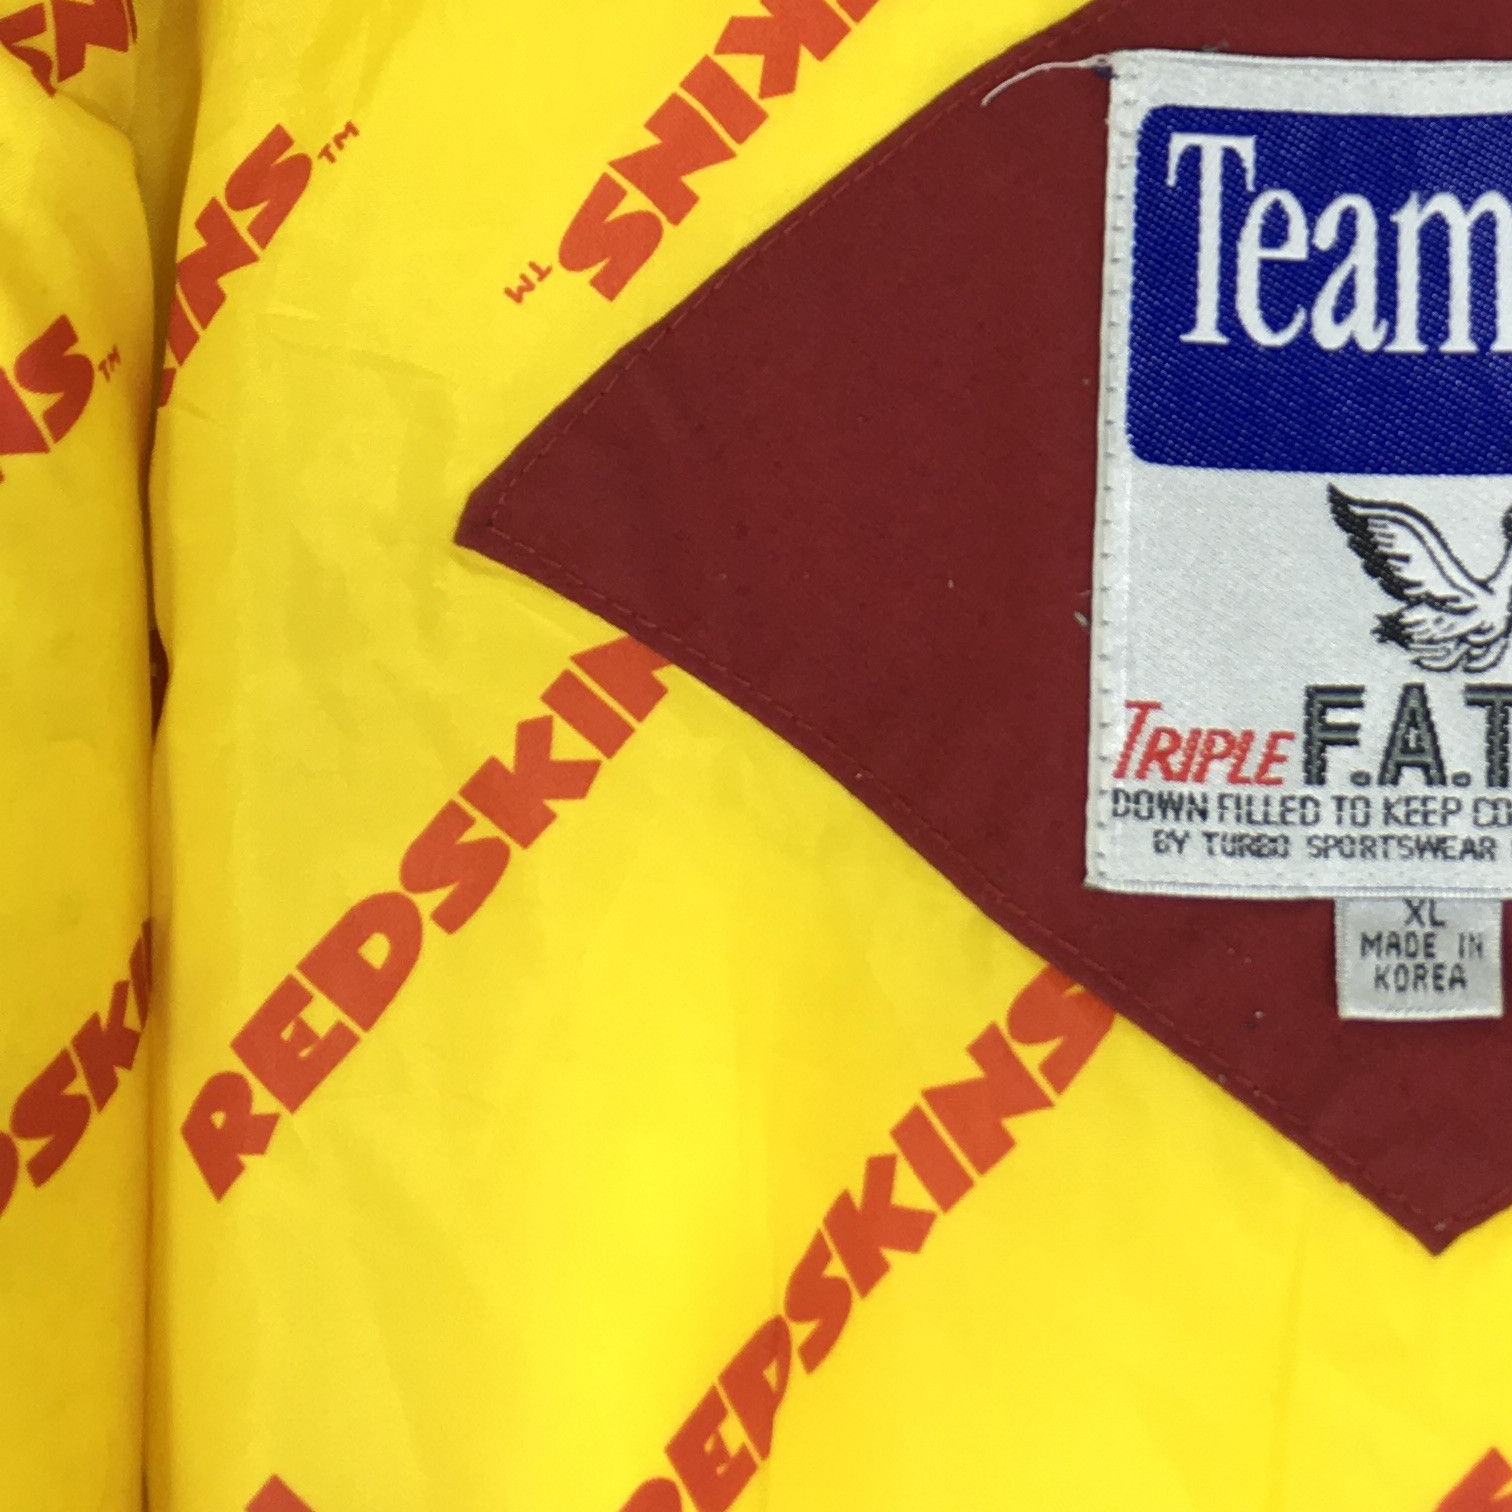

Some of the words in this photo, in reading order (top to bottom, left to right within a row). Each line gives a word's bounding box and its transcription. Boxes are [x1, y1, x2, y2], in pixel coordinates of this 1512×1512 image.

[1113, 700, 1295, 786] TRIPLE
[1111, 788, 1207, 823] DOWN
[1217, 792, 1321, 827] FILLED
[1331, 794, 1371, 828] TO
[1382, 794, 1463, 828] KEEP
[1152, 829, 1190, 855] BY
[1201, 831, 1290, 859] TURBO
[1307, 834, 1497, 861] SPORTSWEAR
[1402, 898, 1446, 928] XL
[1359, 931, 1437, 960] MADE
[1457, 932, 1484, 959] IN
[1374, 963, 1468, 993] KOREA
